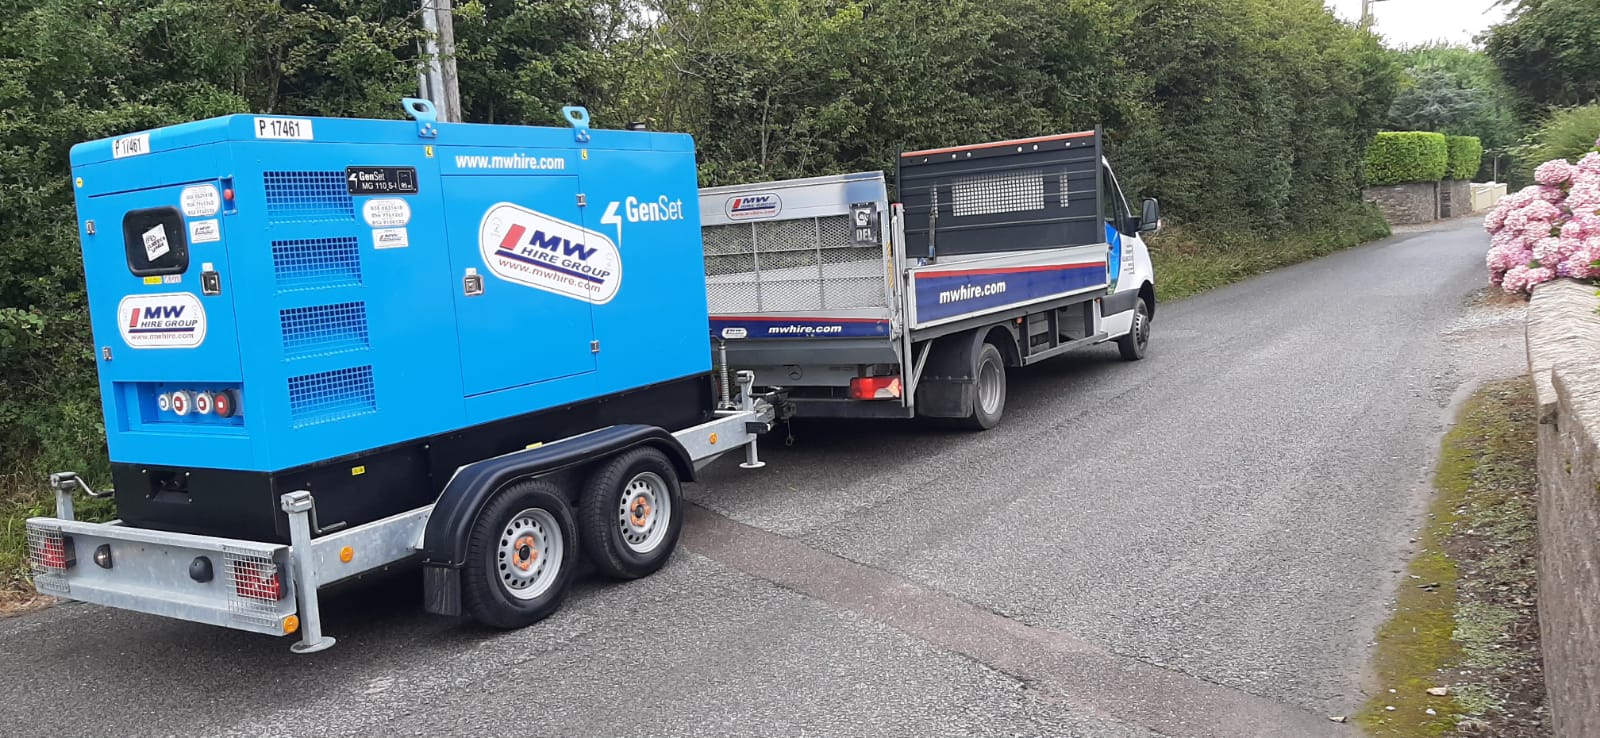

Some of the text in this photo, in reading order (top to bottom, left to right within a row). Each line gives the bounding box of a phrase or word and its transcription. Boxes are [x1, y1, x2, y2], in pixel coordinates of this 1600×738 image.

[258, 119, 300, 137] P 17461
[115, 137, 142, 156] P 17461
[455, 153, 565, 170] www.mwhire.com
[358, 171, 386, 181] GenSet
[361, 182, 374, 190] MG
[625, 194, 684, 223] GenSet
[742, 196, 770, 204] MW
[856, 228, 873, 242] DEL
[529, 230, 597, 261] MW
[521, 247, 611, 278] HIRE GROUP
[498, 259, 601, 293] www.mwhire.com
[939, 281, 1006, 304] mwhire.com
[144, 305, 186, 320] MW
[141, 319, 198, 328] HIRE GROUP
[768, 324, 842, 334] mwhire.com
